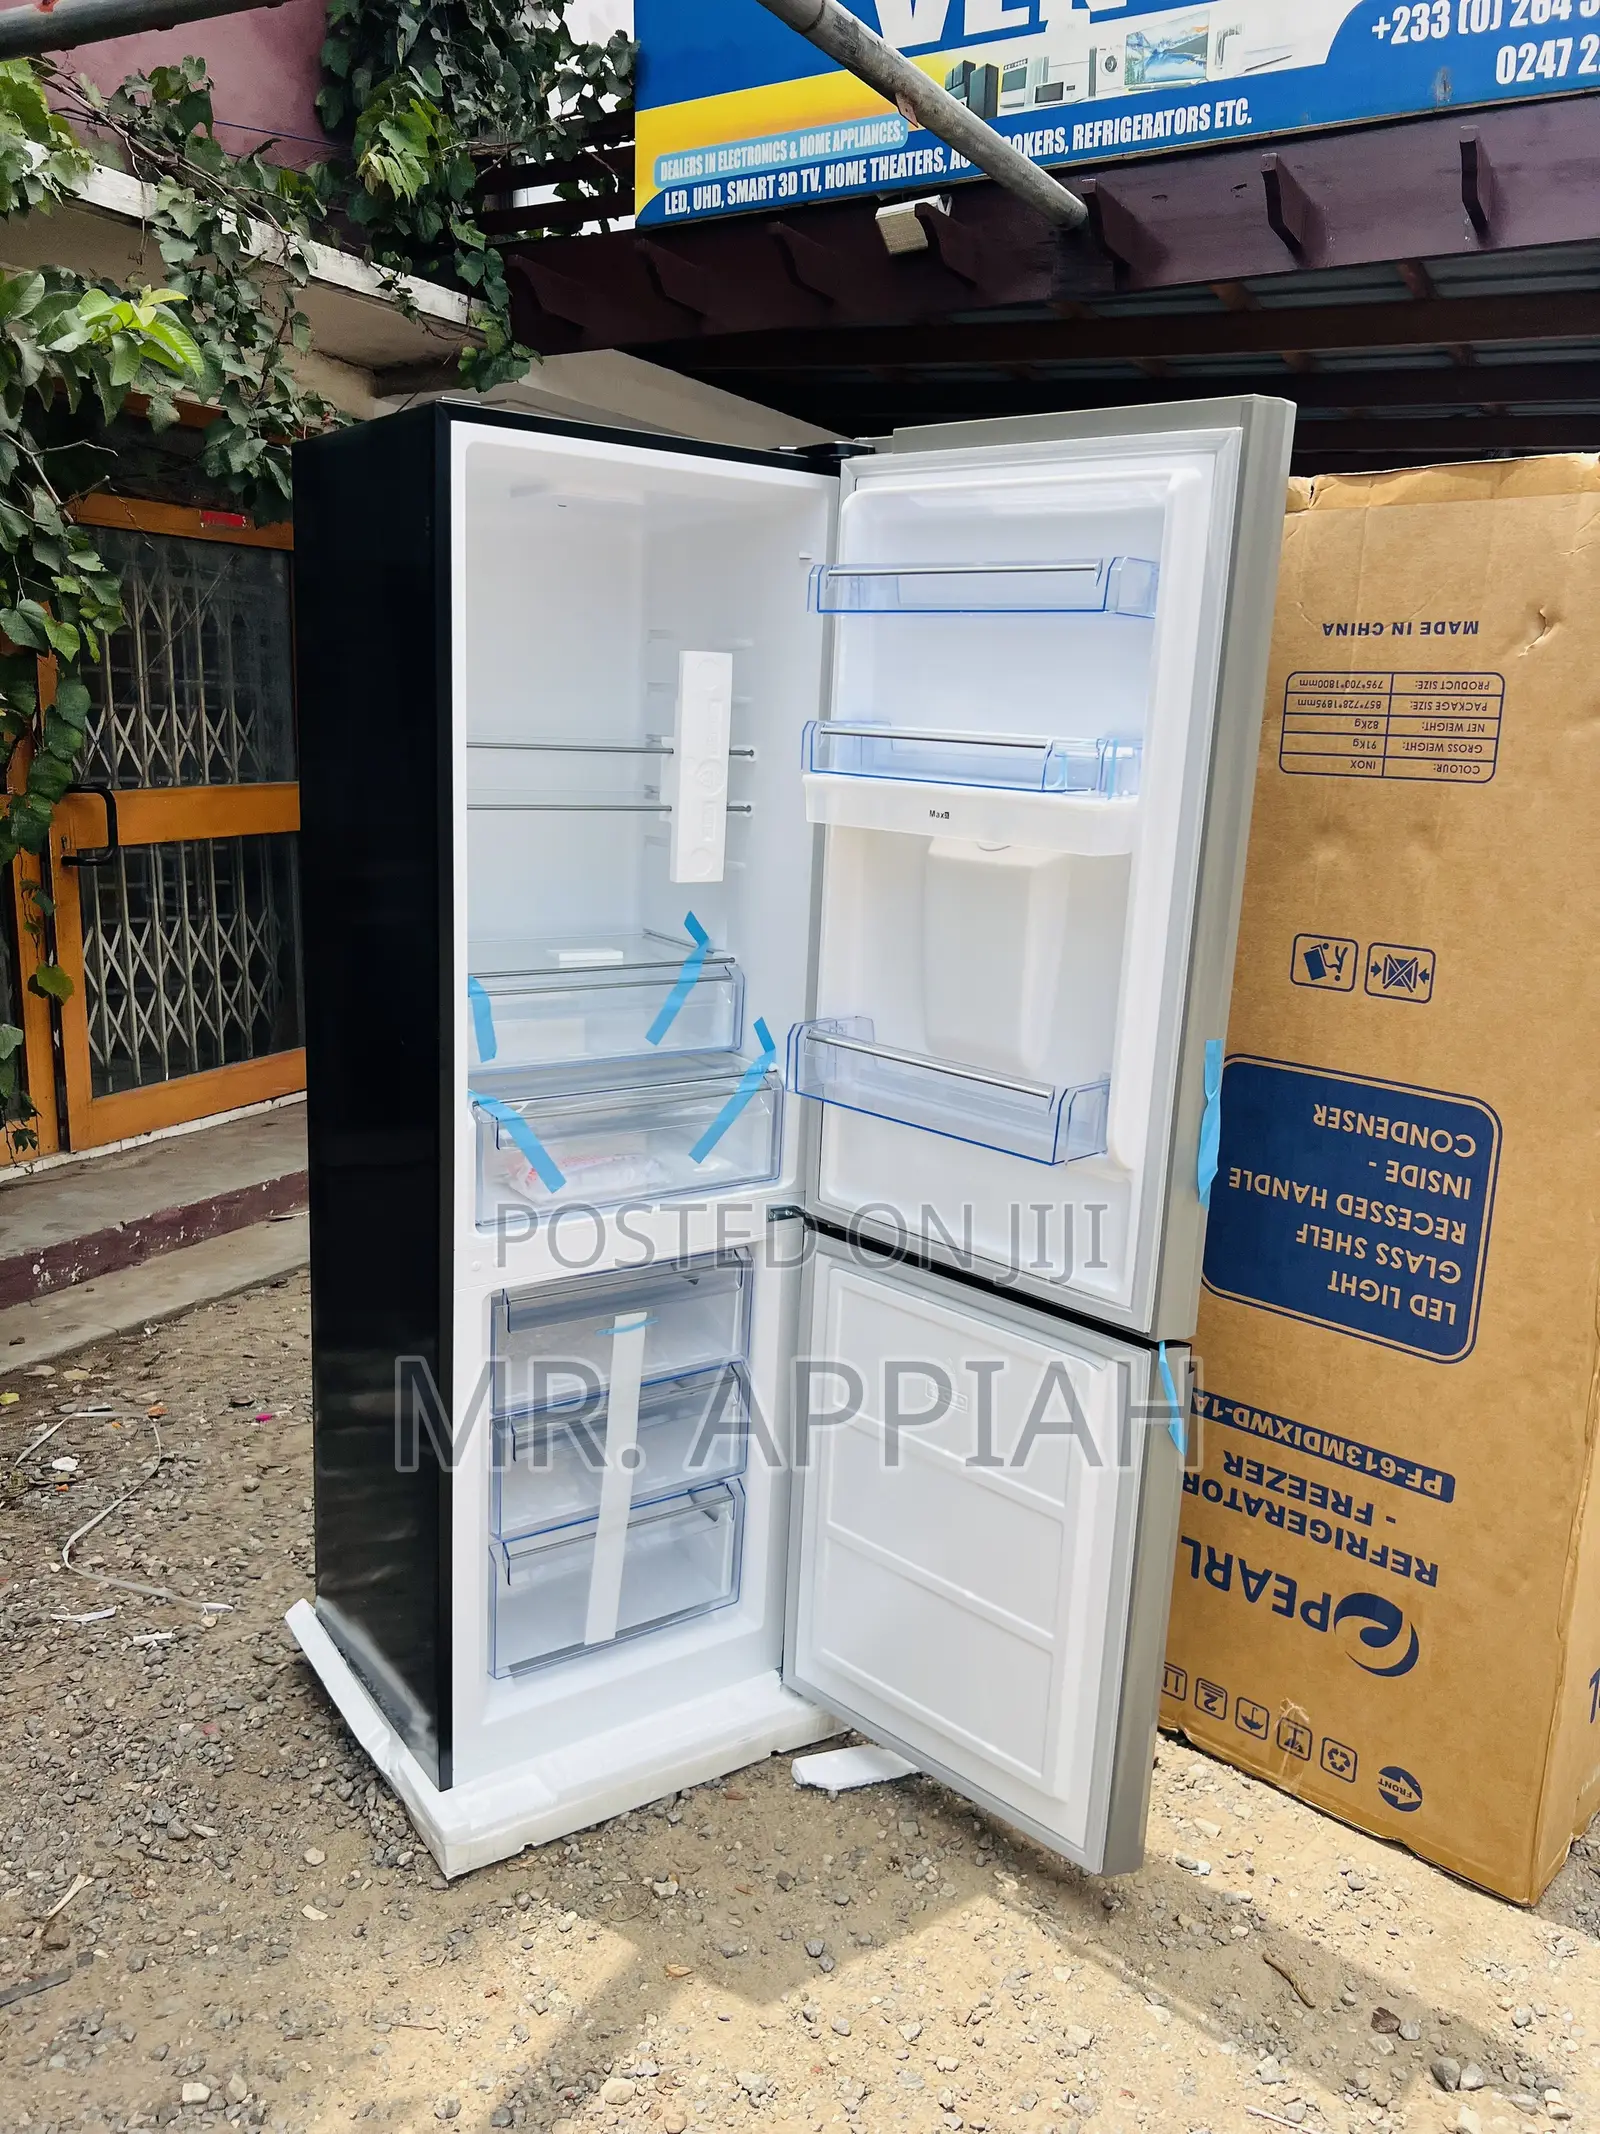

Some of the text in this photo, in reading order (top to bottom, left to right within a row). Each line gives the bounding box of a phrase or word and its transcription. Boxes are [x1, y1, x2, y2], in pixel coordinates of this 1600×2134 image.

[1371, 0, 1450, 46] +233
[1495, 36, 1574, 86] 0247
[660, 119, 904, 182] DEALERS IN ELECTRONICS & HOME APPLIANCES:
[664, 190, 690, 216] LED,
[692, 184, 725, 212] UHD,
[726, 174, 776, 206] SMART
[778, 170, 798, 198] 3D
[800, 166, 822, 194] TV,
[824, 158, 867, 190] HOME
[869, 146, 948, 182] THEATERS,
[1072, 106, 1212, 152] REFRIGERATORS
[1214, 96, 1253, 129] ETC.
[1322, 620, 1479, 636] MADE IN CHINA
[1410, 701, 1433, 711] SIZE:
[1415, 680, 1438, 690] SIZE:
[1435, 701, 1488, 712] PACKAGE
[1440, 680, 1490, 690] PRODUCT
[1352, 738, 1482, 754] GROSS WEIGHT: 91Kg
[1354, 718, 1485, 732] NET WEIGHT: 82Kg
[1350, 760, 1480, 775] COLOUR: INOX
[1312, 1103, 1476, 1158] CONDENSER
[1385, 1159, 1472, 1200] INSIDE
[1228, 1166, 1467, 1245] RECESSED HANDLE
[1296, 1222, 1462, 1284] GLASS SHELF
[1327, 1270, 1457, 1326] LED LIGHT
[1222, 1450, 1374, 1527] FREEZER
[1182, 1472, 1439, 1588] REFRIGERATOR
[1180, 1535, 1332, 1632] PEARL
[1204, 1692, 1218, 1712] 2
[1377, 1778, 1413, 1799] FRONT
